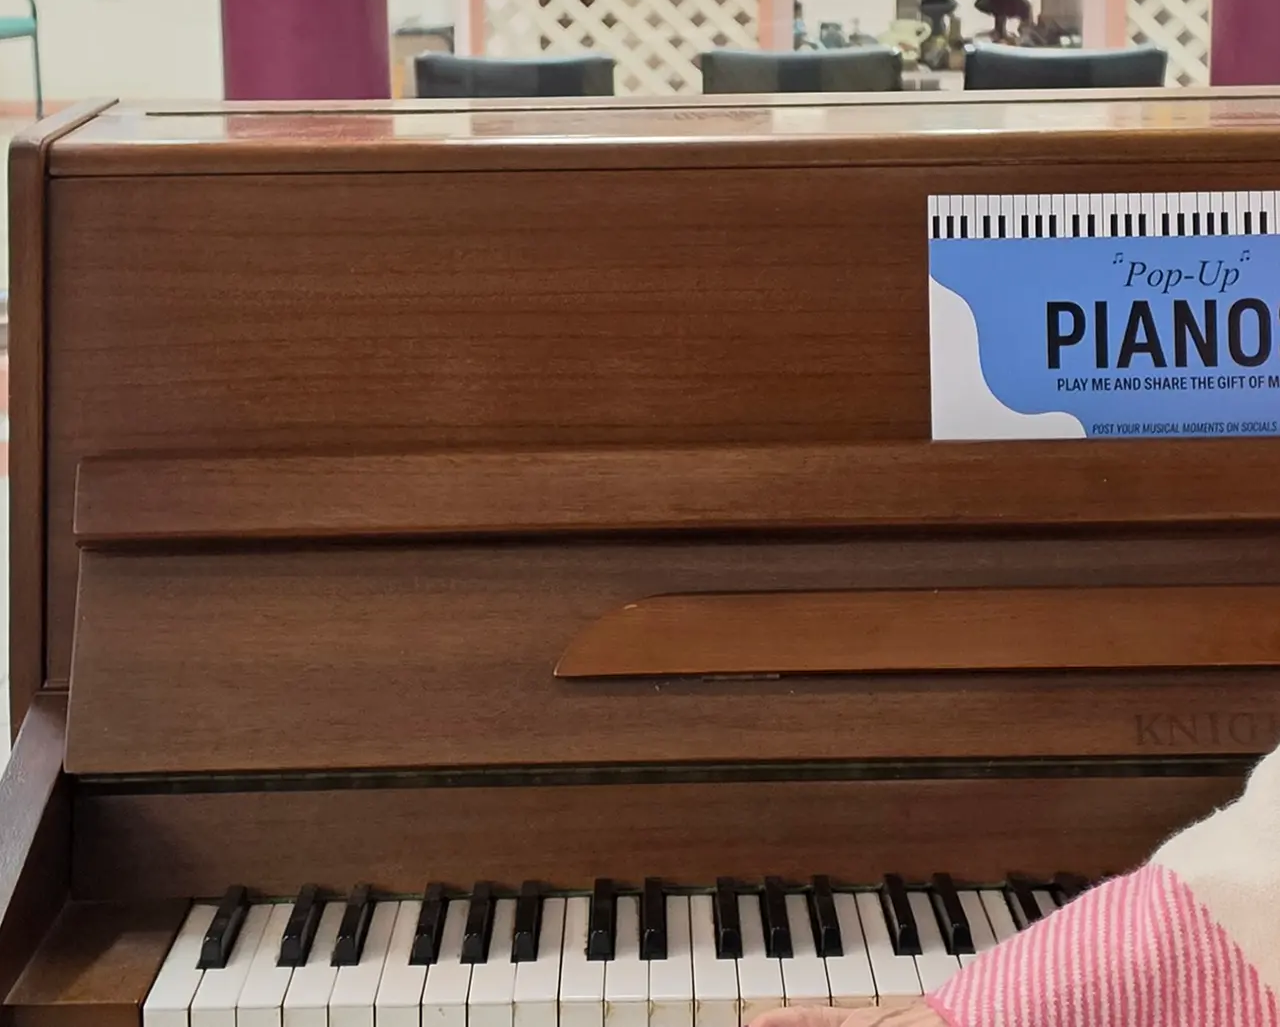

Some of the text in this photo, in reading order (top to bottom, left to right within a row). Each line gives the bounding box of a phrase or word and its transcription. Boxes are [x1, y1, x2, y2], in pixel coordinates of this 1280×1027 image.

[1123, 259, 1241, 294] Pop-Up
[1057, 378, 1088, 392] PLAY
[1091, 378, 1112, 391] ME
[1114, 377, 1141, 391] AND
[1144, 376, 1188, 391] SHARE
[1190, 376, 1214, 390] THE
[1217, 375, 1246, 390] GIFT
[1248, 375, 1265, 389] OF
[1092, 420, 1278, 435] POST YOUR MUSICAL MOMENTS ON SOCIALS
